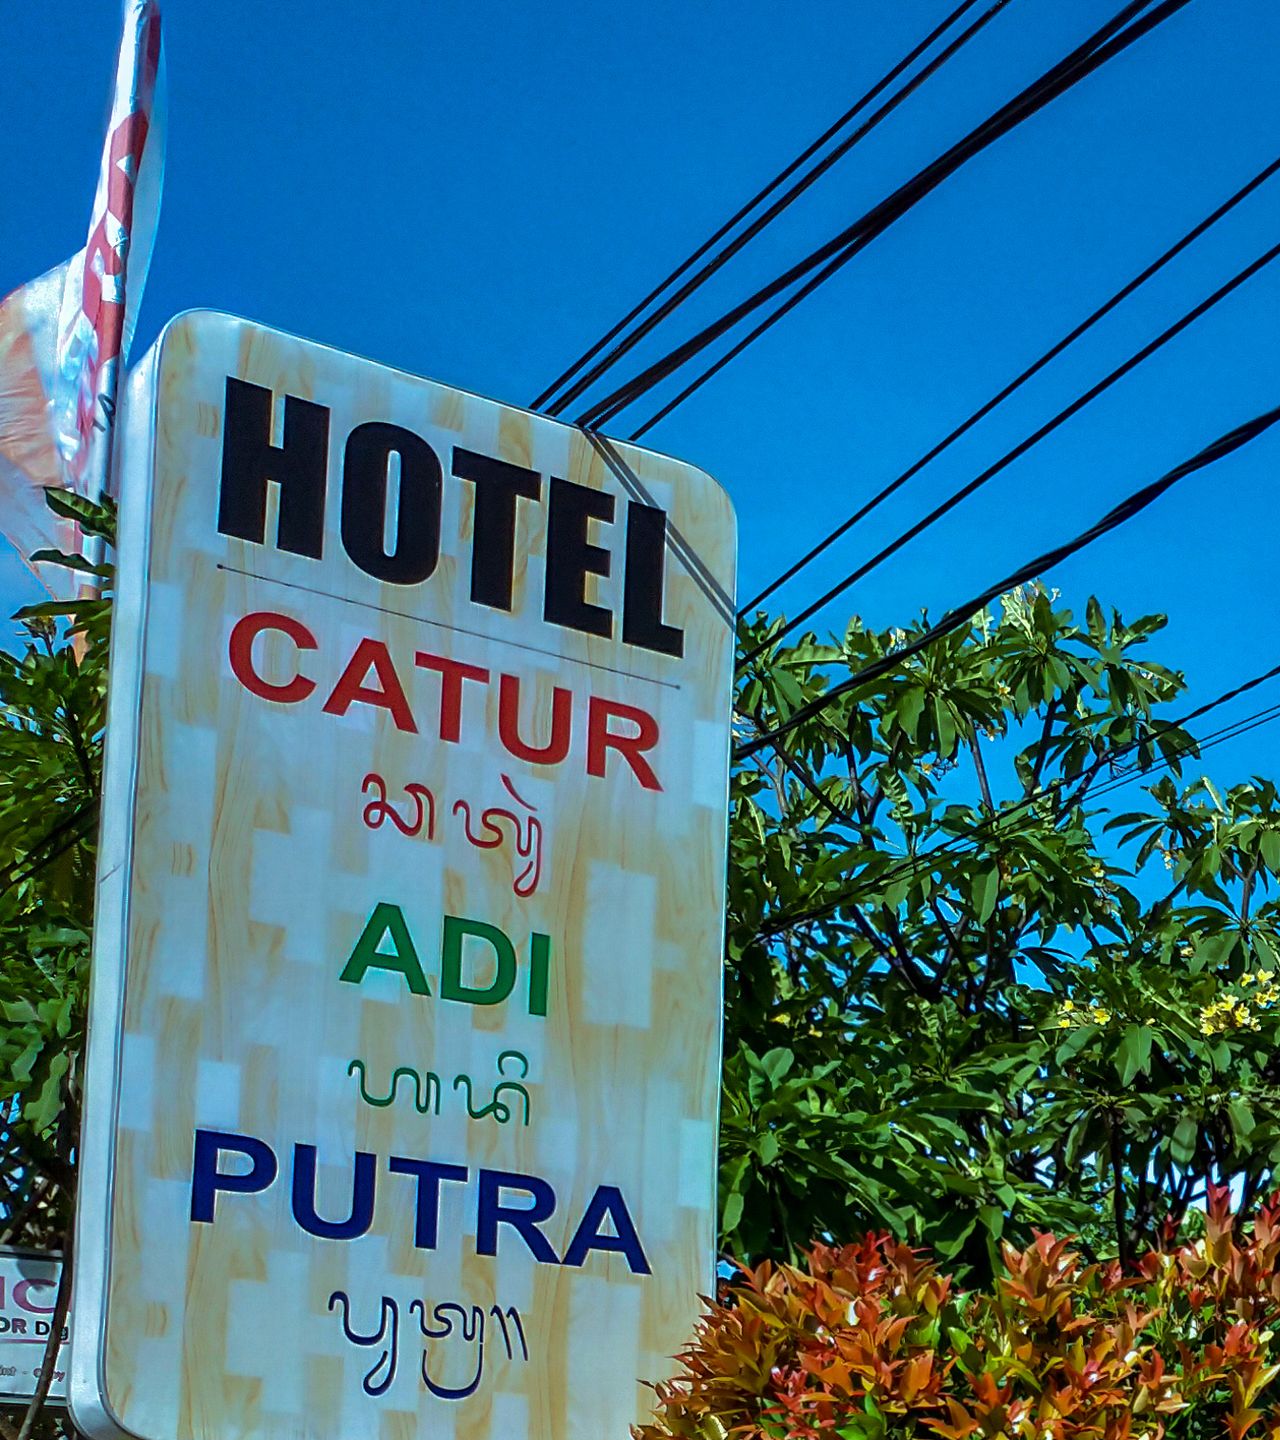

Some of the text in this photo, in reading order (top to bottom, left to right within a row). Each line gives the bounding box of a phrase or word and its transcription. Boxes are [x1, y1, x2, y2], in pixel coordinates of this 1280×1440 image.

[217, 375, 685, 659] HOTEL
[228, 610, 664, 792] CATUR
[339, 902, 551, 1018] ADI
[189, 1127, 653, 1275] PUTRA
